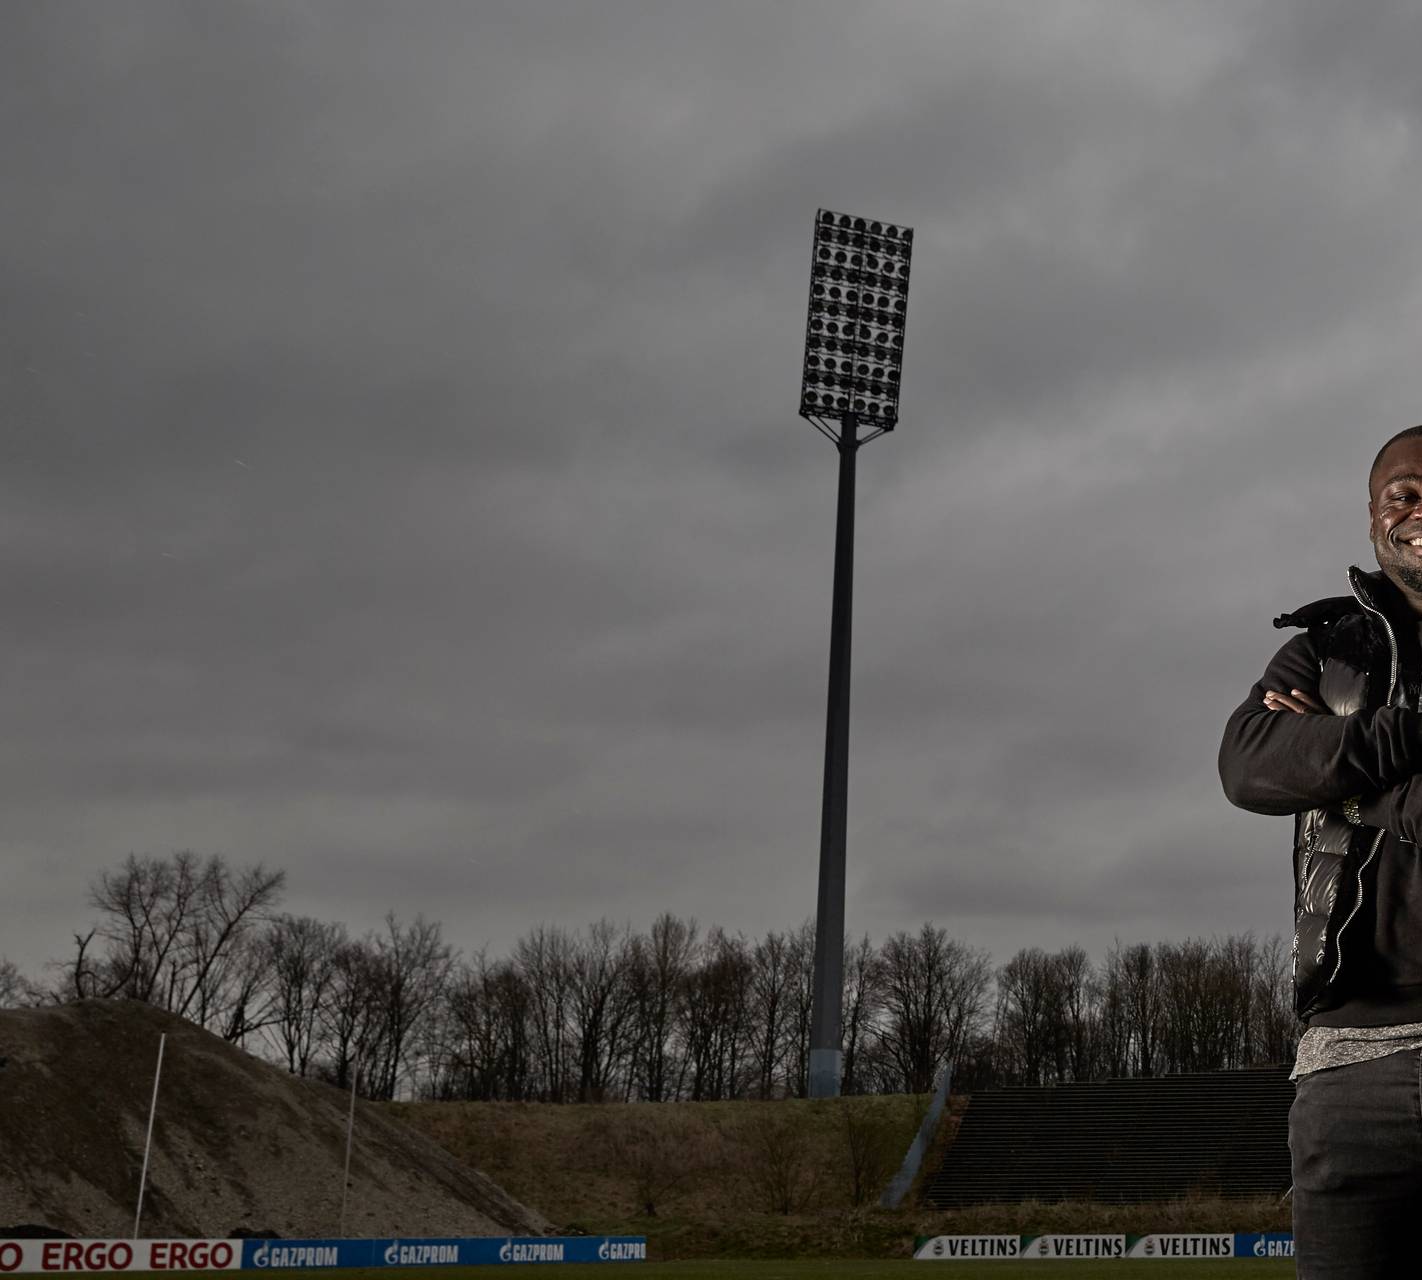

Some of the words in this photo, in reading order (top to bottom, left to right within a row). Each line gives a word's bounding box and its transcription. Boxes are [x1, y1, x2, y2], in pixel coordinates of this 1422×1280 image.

[42, 1242, 133, 1270] ERGO
[150, 1242, 233, 1269] ERGO
[270, 1246, 338, 1267] GAZPROM
[400, 1245, 459, 1264] GAZPROM
[512, 1244, 564, 1262] GAZPROM
[610, 1242, 646, 1260] GAZPRO
[948, 1238, 1017, 1256] VELTINS
[1053, 1238, 1123, 1257] VELTINS
[1159, 1237, 1231, 1256] VELTINS
[1267, 1240, 1296, 1257] GAZP
